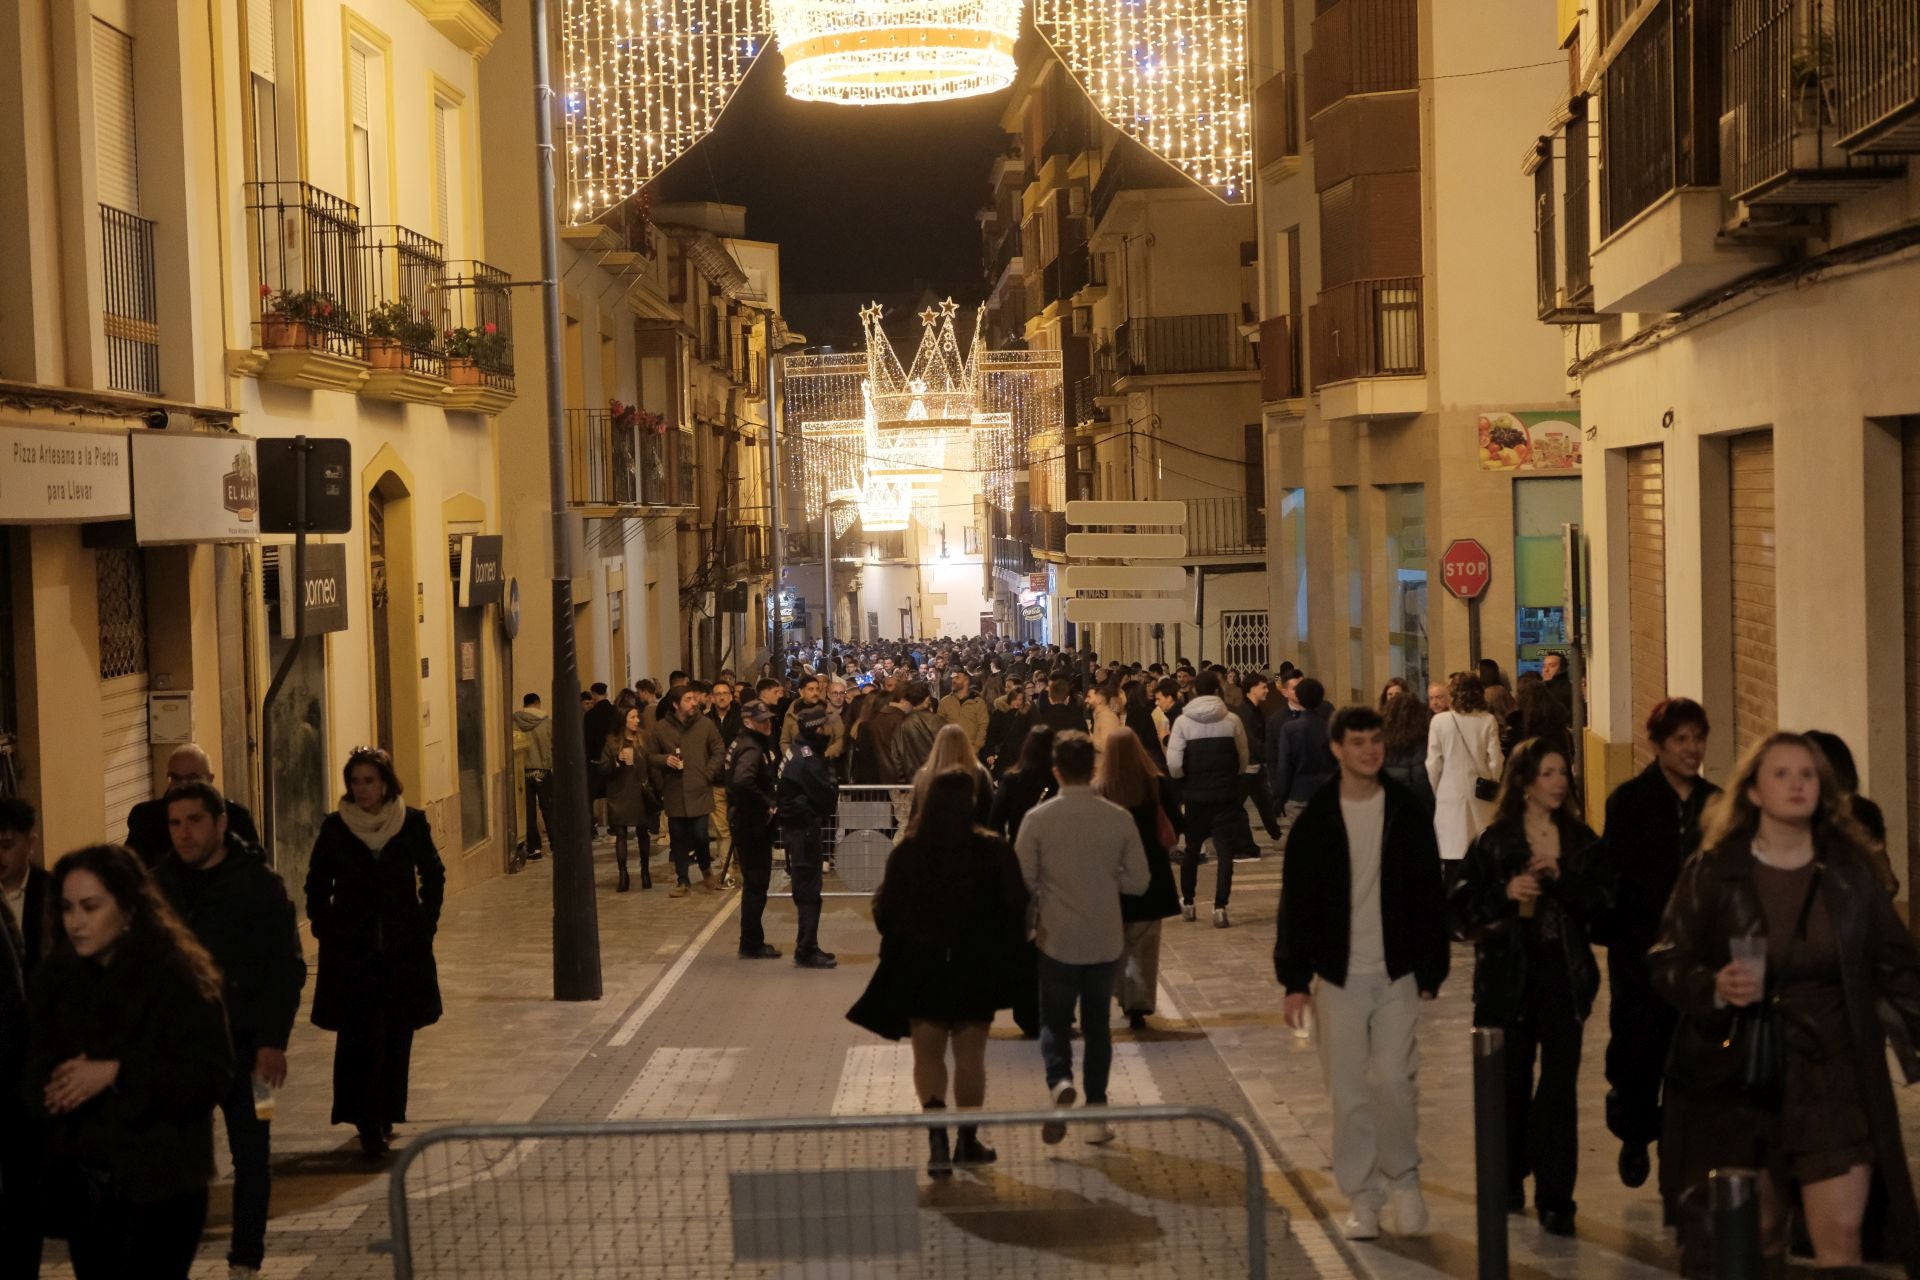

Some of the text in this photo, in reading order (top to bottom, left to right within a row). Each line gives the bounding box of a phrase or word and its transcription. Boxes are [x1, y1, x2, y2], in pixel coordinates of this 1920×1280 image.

[14, 442, 119, 466] Pizza Artesana a la Piedra
[47, 480, 92, 504] para Llevar
[228, 485, 238, 500] EL
[475, 557, 497, 584] borneo
[1446, 562, 1486, 577] STOP
